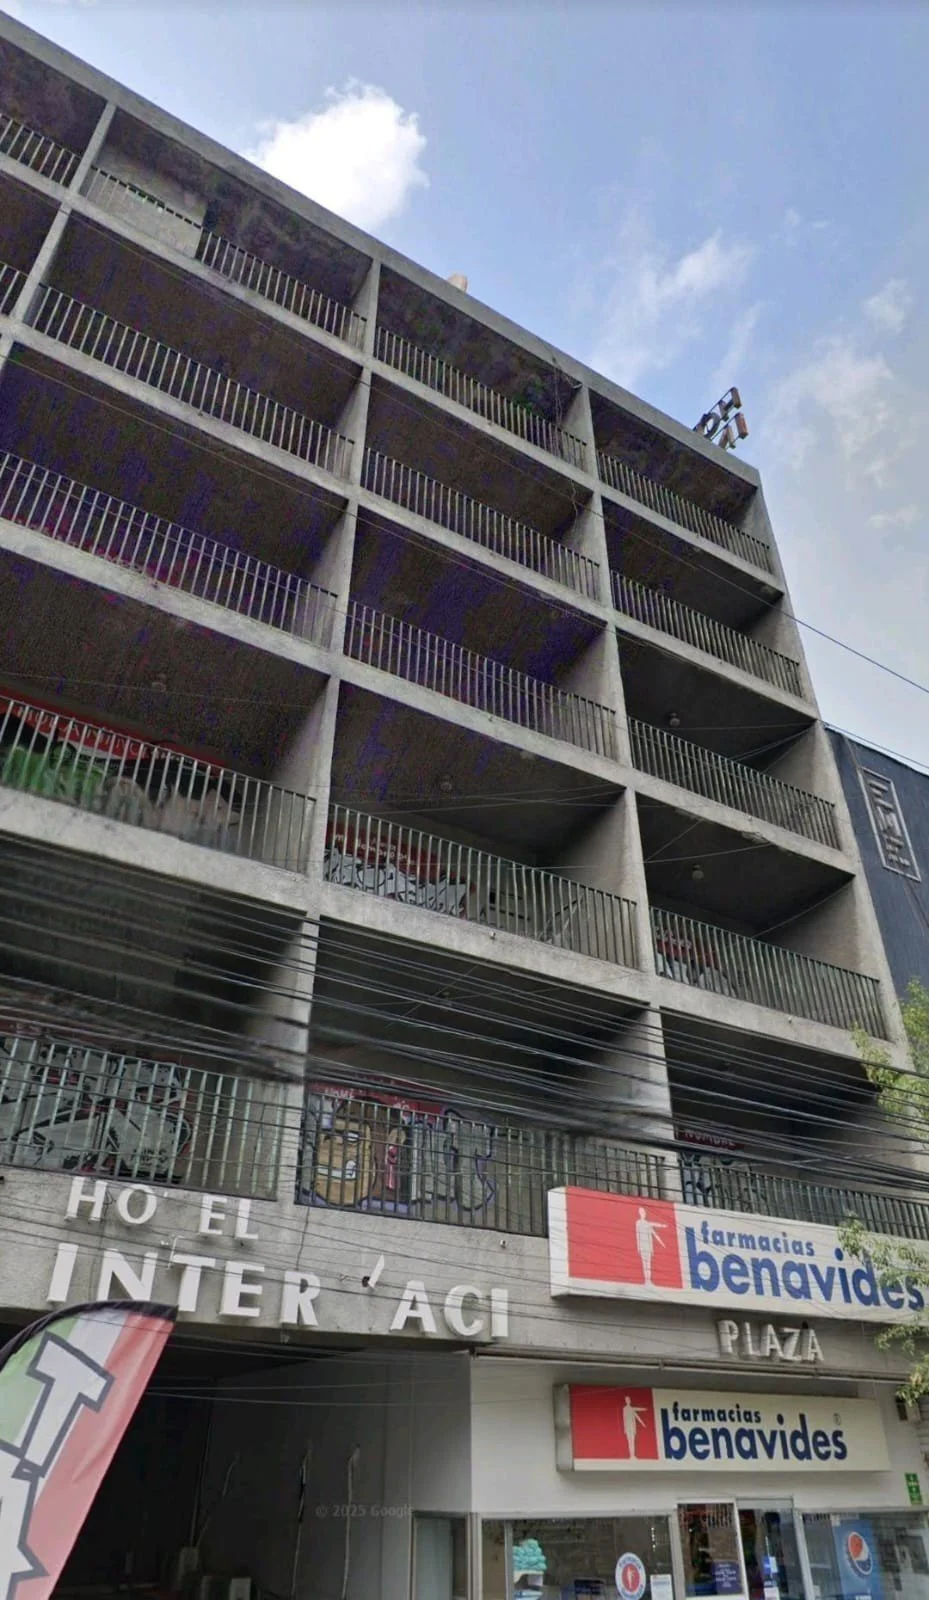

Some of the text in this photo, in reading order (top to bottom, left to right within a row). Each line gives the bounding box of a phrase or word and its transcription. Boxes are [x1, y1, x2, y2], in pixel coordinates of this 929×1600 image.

[701, 1221, 815, 1257] farmacias
[685, 1227, 925, 1312] benavides
[716, 1320, 825, 1362] PLAZA
[673, 1402, 762, 1424] farmacias
[661, 1408, 848, 1461] benavides
